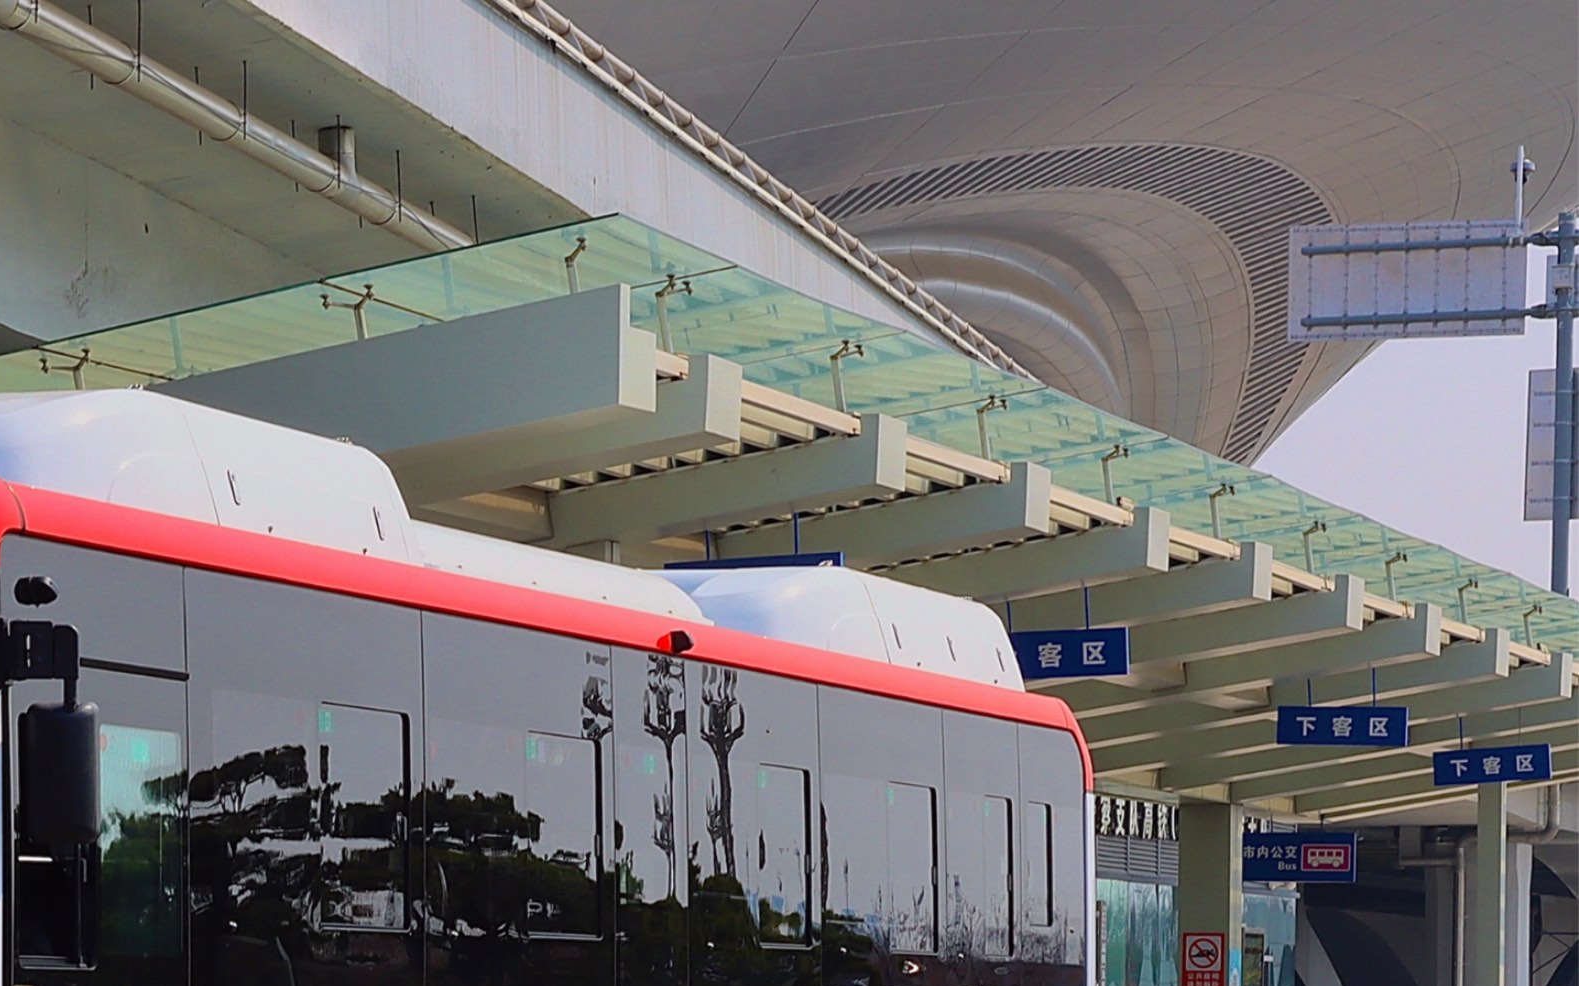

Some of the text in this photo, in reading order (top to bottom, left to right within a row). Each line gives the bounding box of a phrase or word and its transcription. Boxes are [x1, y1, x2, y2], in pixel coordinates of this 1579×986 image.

[1014, 642, 1106, 668] 客区
[1296, 716, 1389, 738] 下客区
[1450, 754, 1534, 778] 下客区
[1243, 845, 1297, 859] 市内公交
[1278, 861, 1297, 871] Bus
